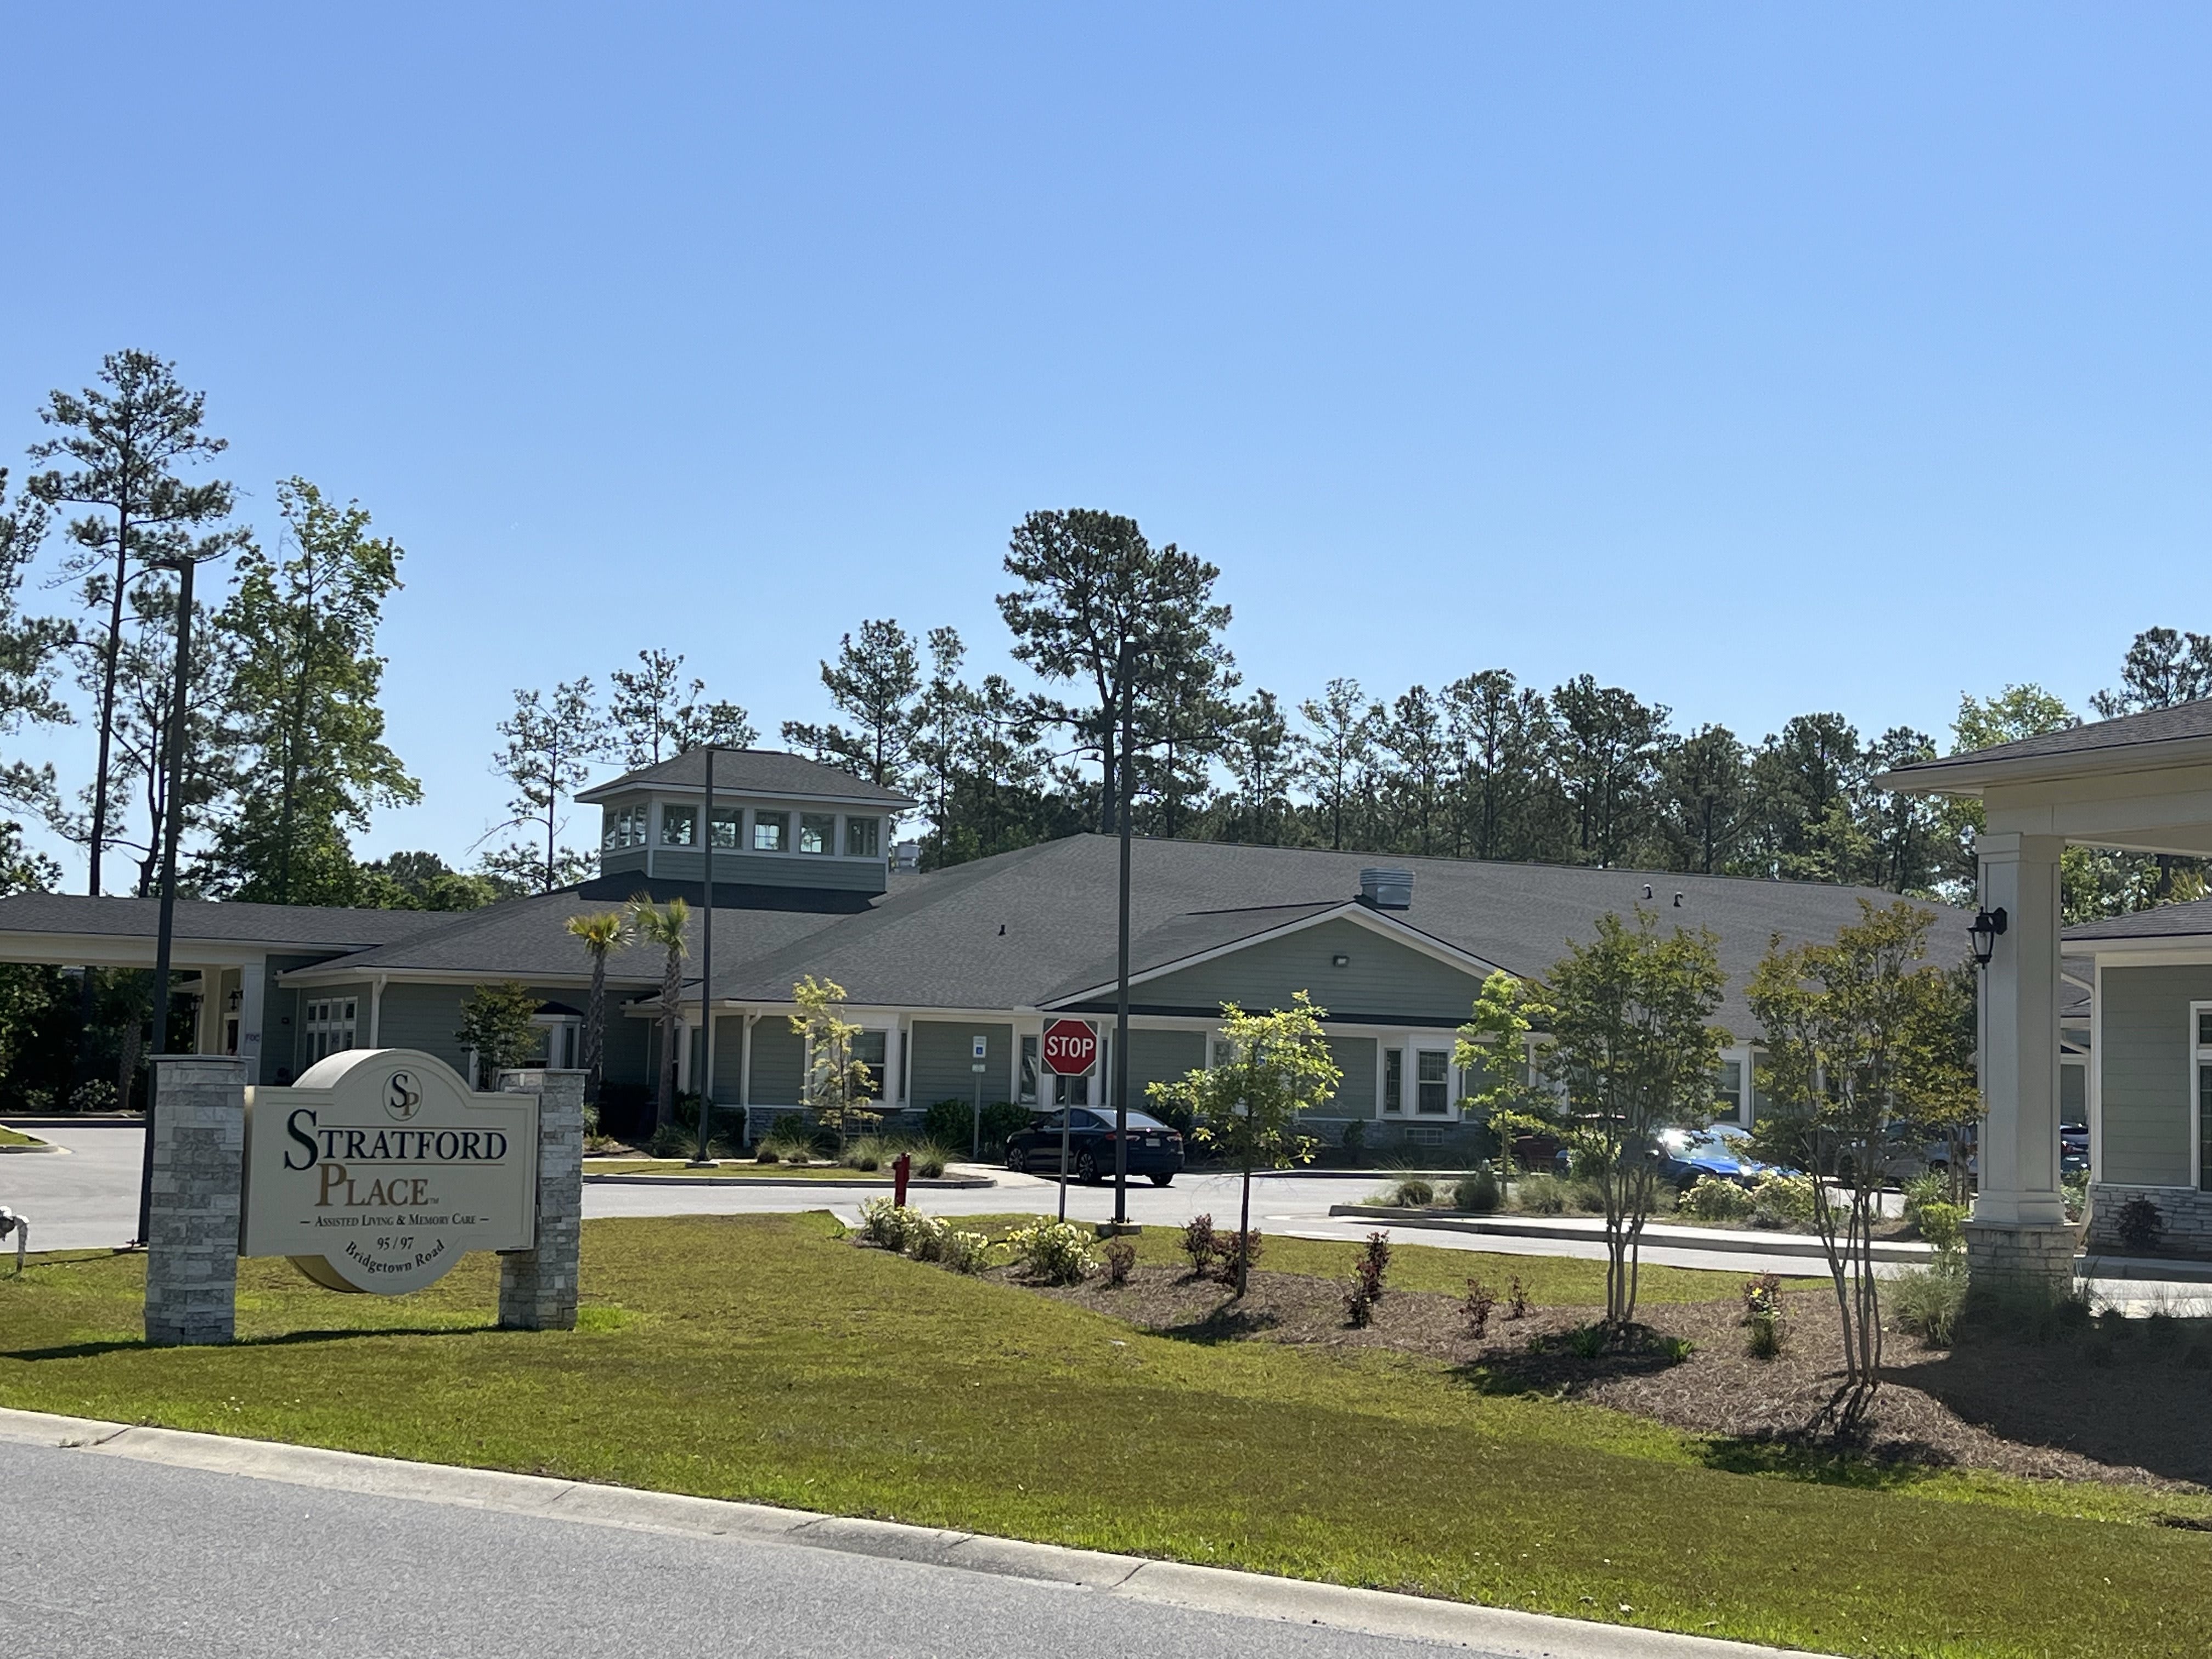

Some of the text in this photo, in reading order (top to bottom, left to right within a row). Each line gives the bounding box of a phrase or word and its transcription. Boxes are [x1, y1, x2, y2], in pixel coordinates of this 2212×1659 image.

[1047, 1036, 1093, 1058] STOP
[284, 1109, 507, 1170] STRATFORD
[315, 1164, 428, 1206] PLACE
[315, 1212, 476, 1227] ASSISTED LIVING & MEMORY CARE
[345, 1239, 445, 1273] Bridgetown Road
